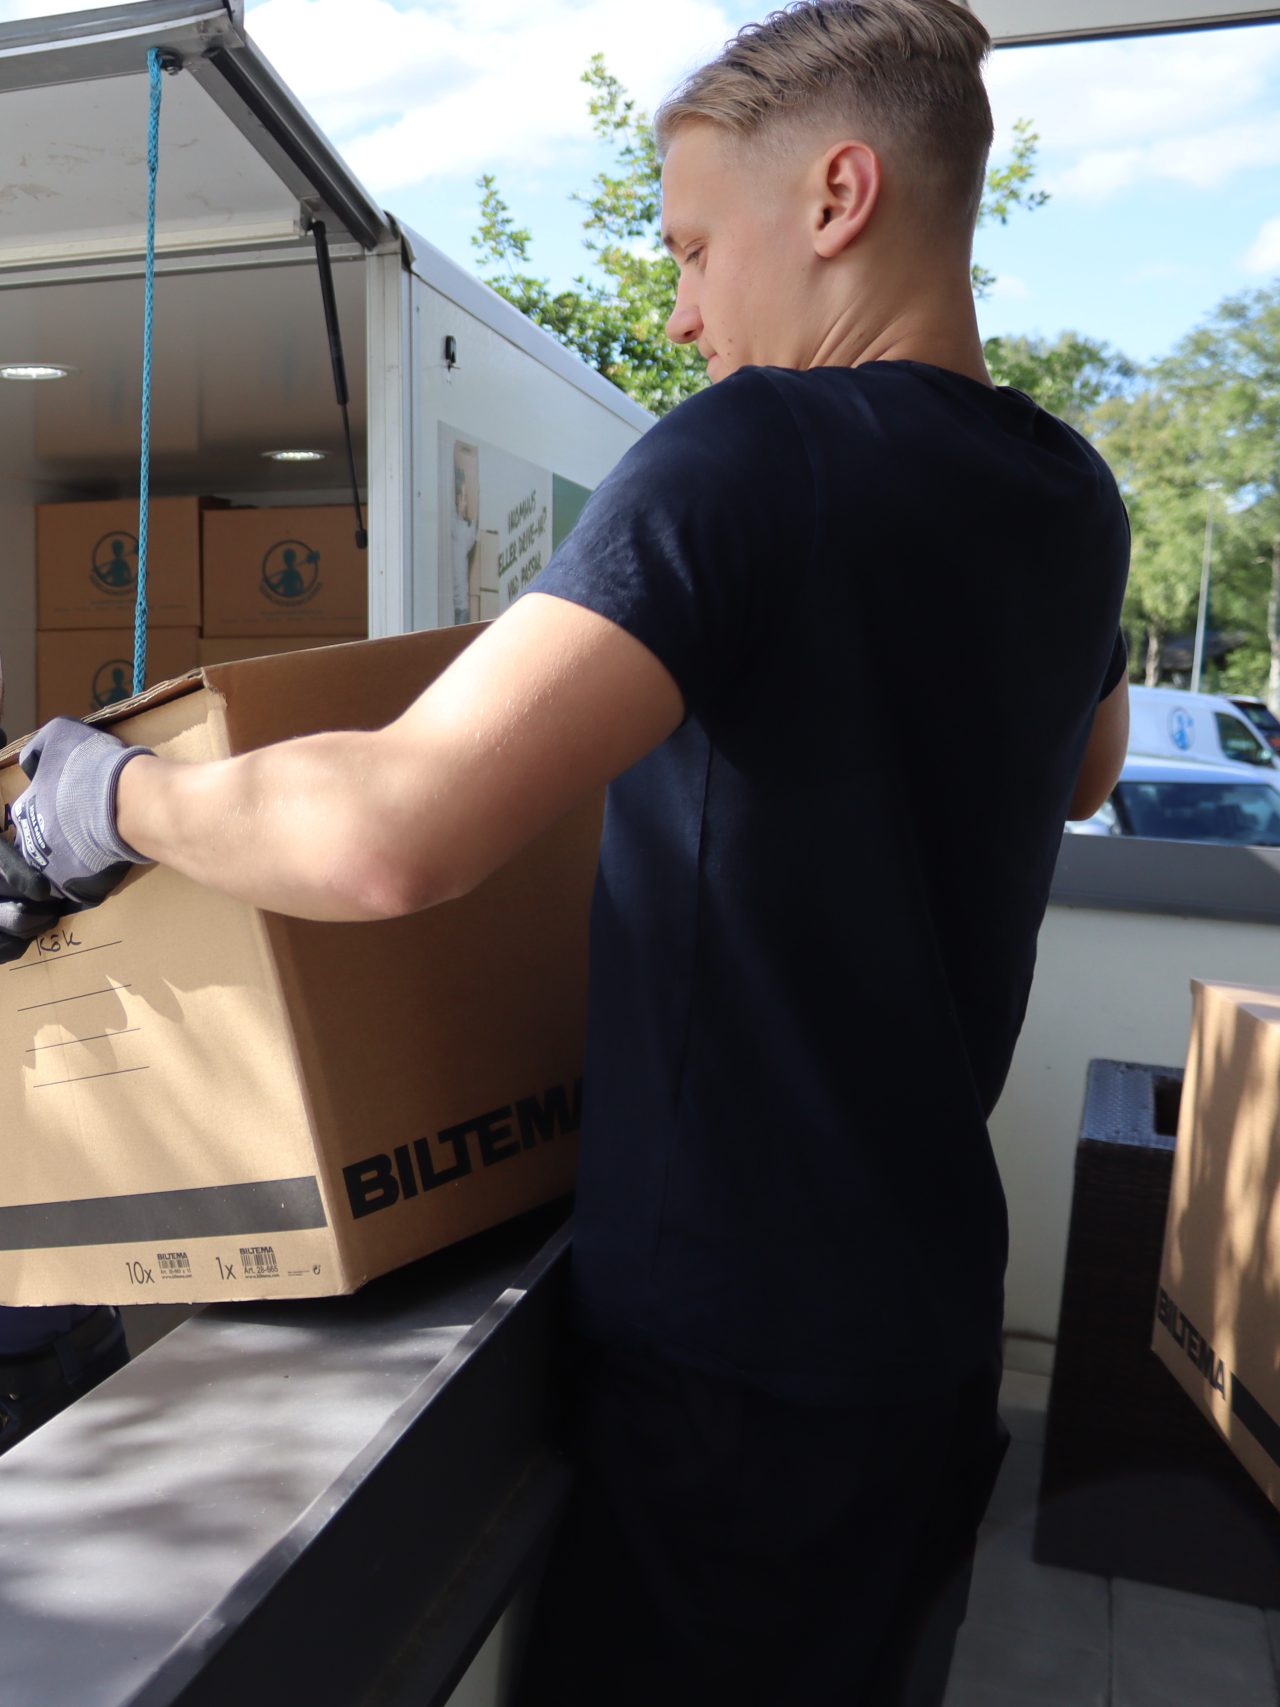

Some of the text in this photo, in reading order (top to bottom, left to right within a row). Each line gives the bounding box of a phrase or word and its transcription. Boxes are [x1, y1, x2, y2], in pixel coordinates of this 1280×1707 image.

[498, 541, 518, 577] ELLER
[342, 1076, 584, 1220] BILTEM
[157, 1252, 188, 1261] BILTEMA
[239, 1246, 274, 1255] BILTEMA
[125, 1261, 156, 1285] 10x
[216, 1256, 237, 1281] 1x
[1158, 1287, 1226, 1402] BILTEMA
